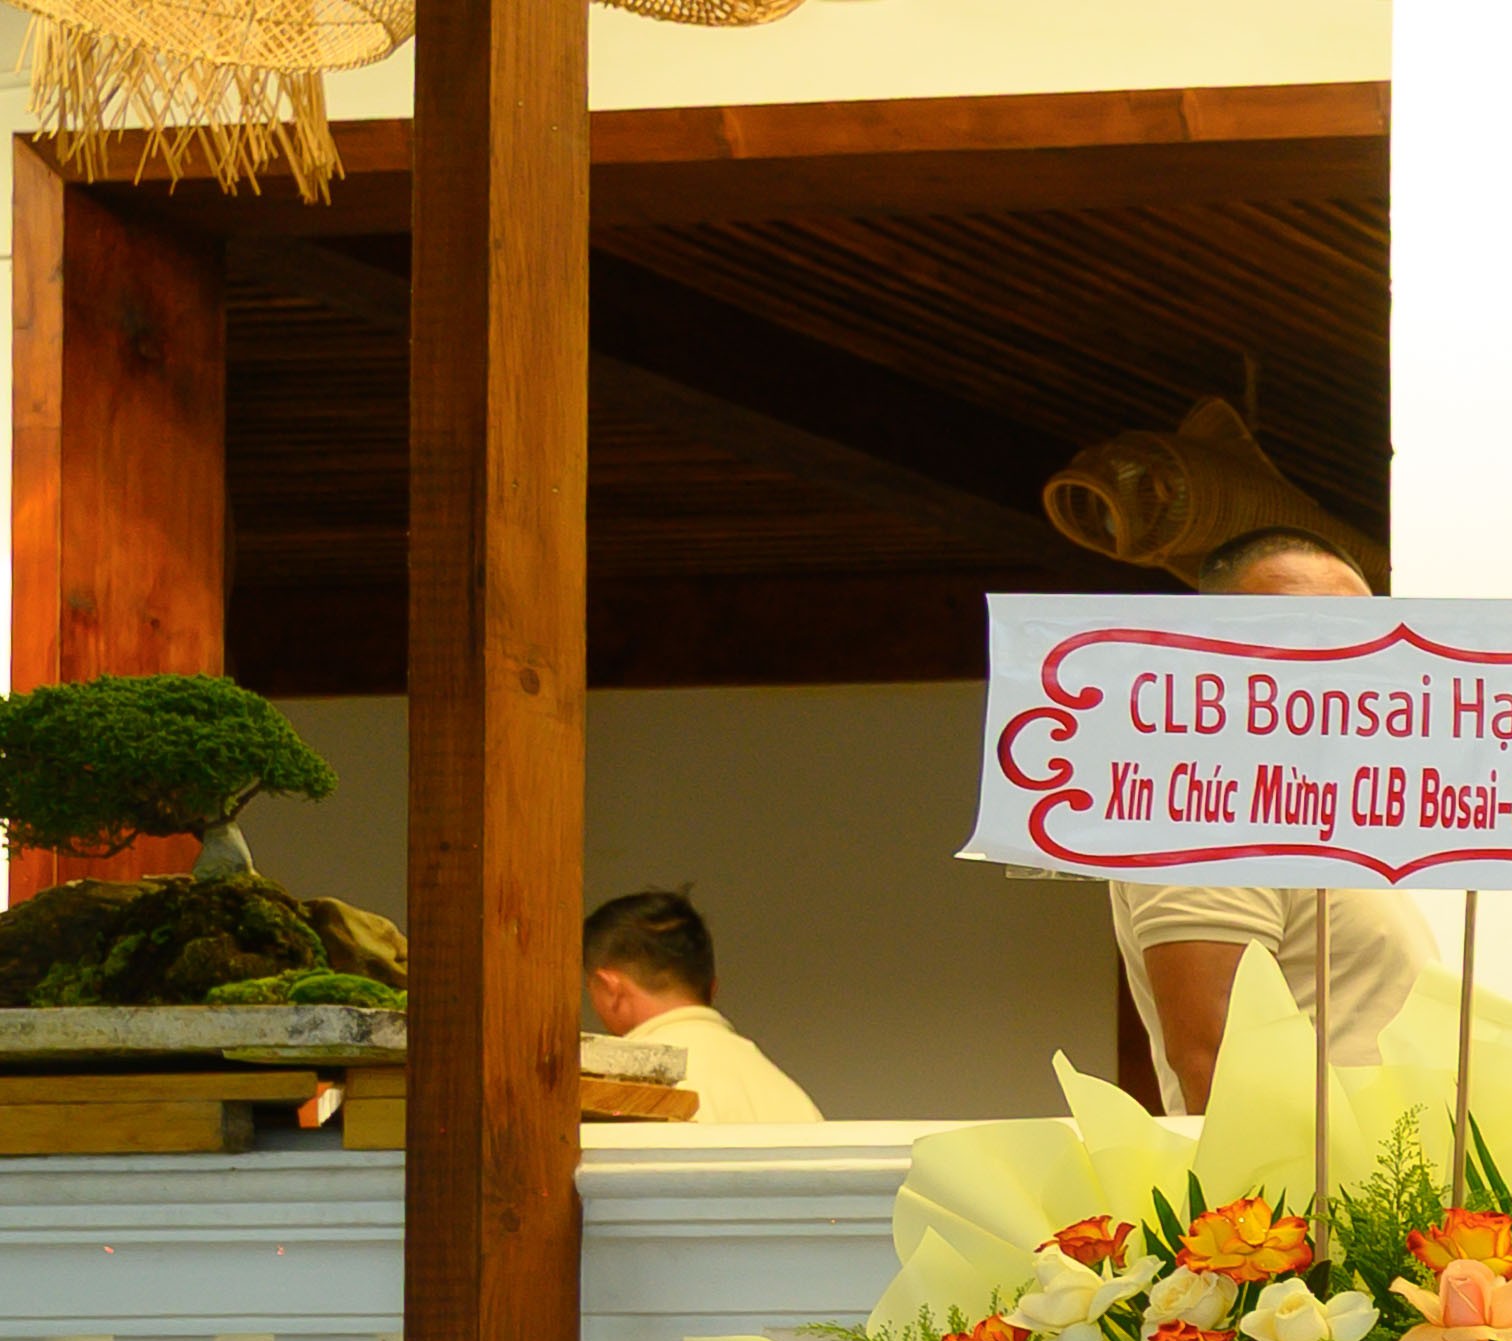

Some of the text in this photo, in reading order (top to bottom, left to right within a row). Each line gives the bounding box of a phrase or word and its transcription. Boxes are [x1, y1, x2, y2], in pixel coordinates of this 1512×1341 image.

[1129, 672, 1227, 735] CLB
[1246, 673, 1431, 738] Bonsai
[1104, 761, 1154, 821] Xin
[1167, 762, 1239, 823] Chúc
[1249, 764, 1338, 842] Mừng
[1351, 766, 1407, 827] CLB
